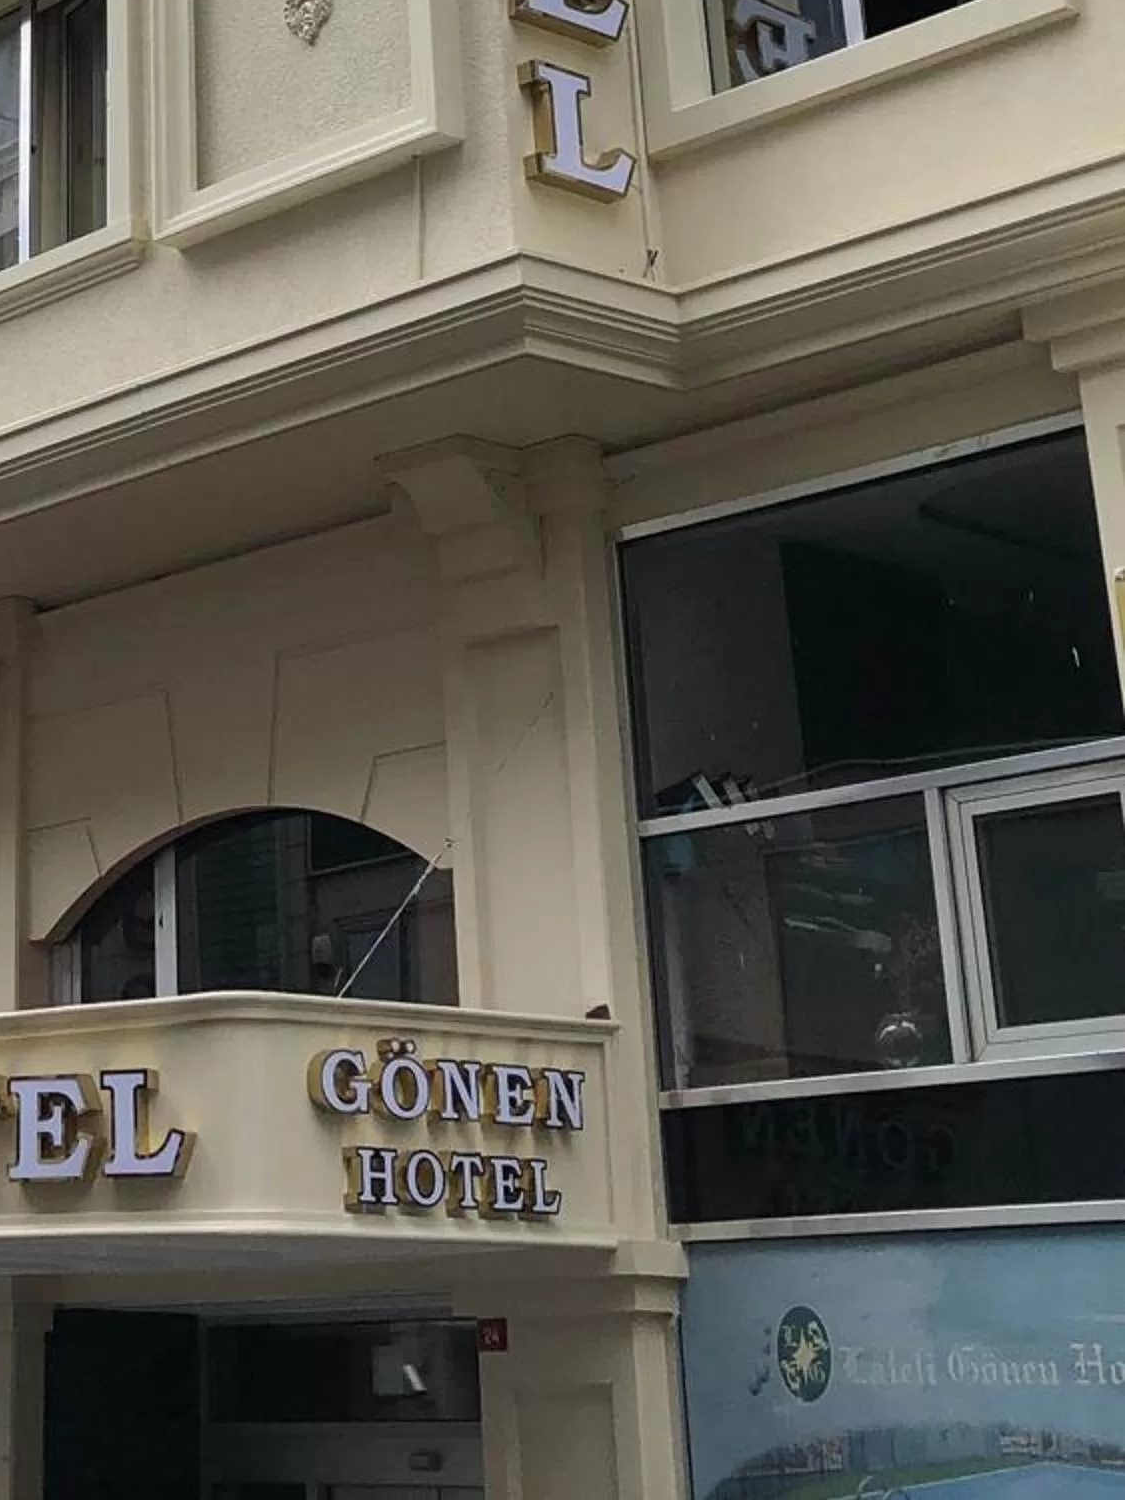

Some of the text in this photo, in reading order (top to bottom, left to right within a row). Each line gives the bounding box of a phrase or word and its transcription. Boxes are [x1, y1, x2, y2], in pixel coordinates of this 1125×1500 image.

[310, 1038, 584, 1129] GÖNEN
[345, 1146, 561, 1214] HOTEL
[947, 1344, 1060, 1387] Gönen
